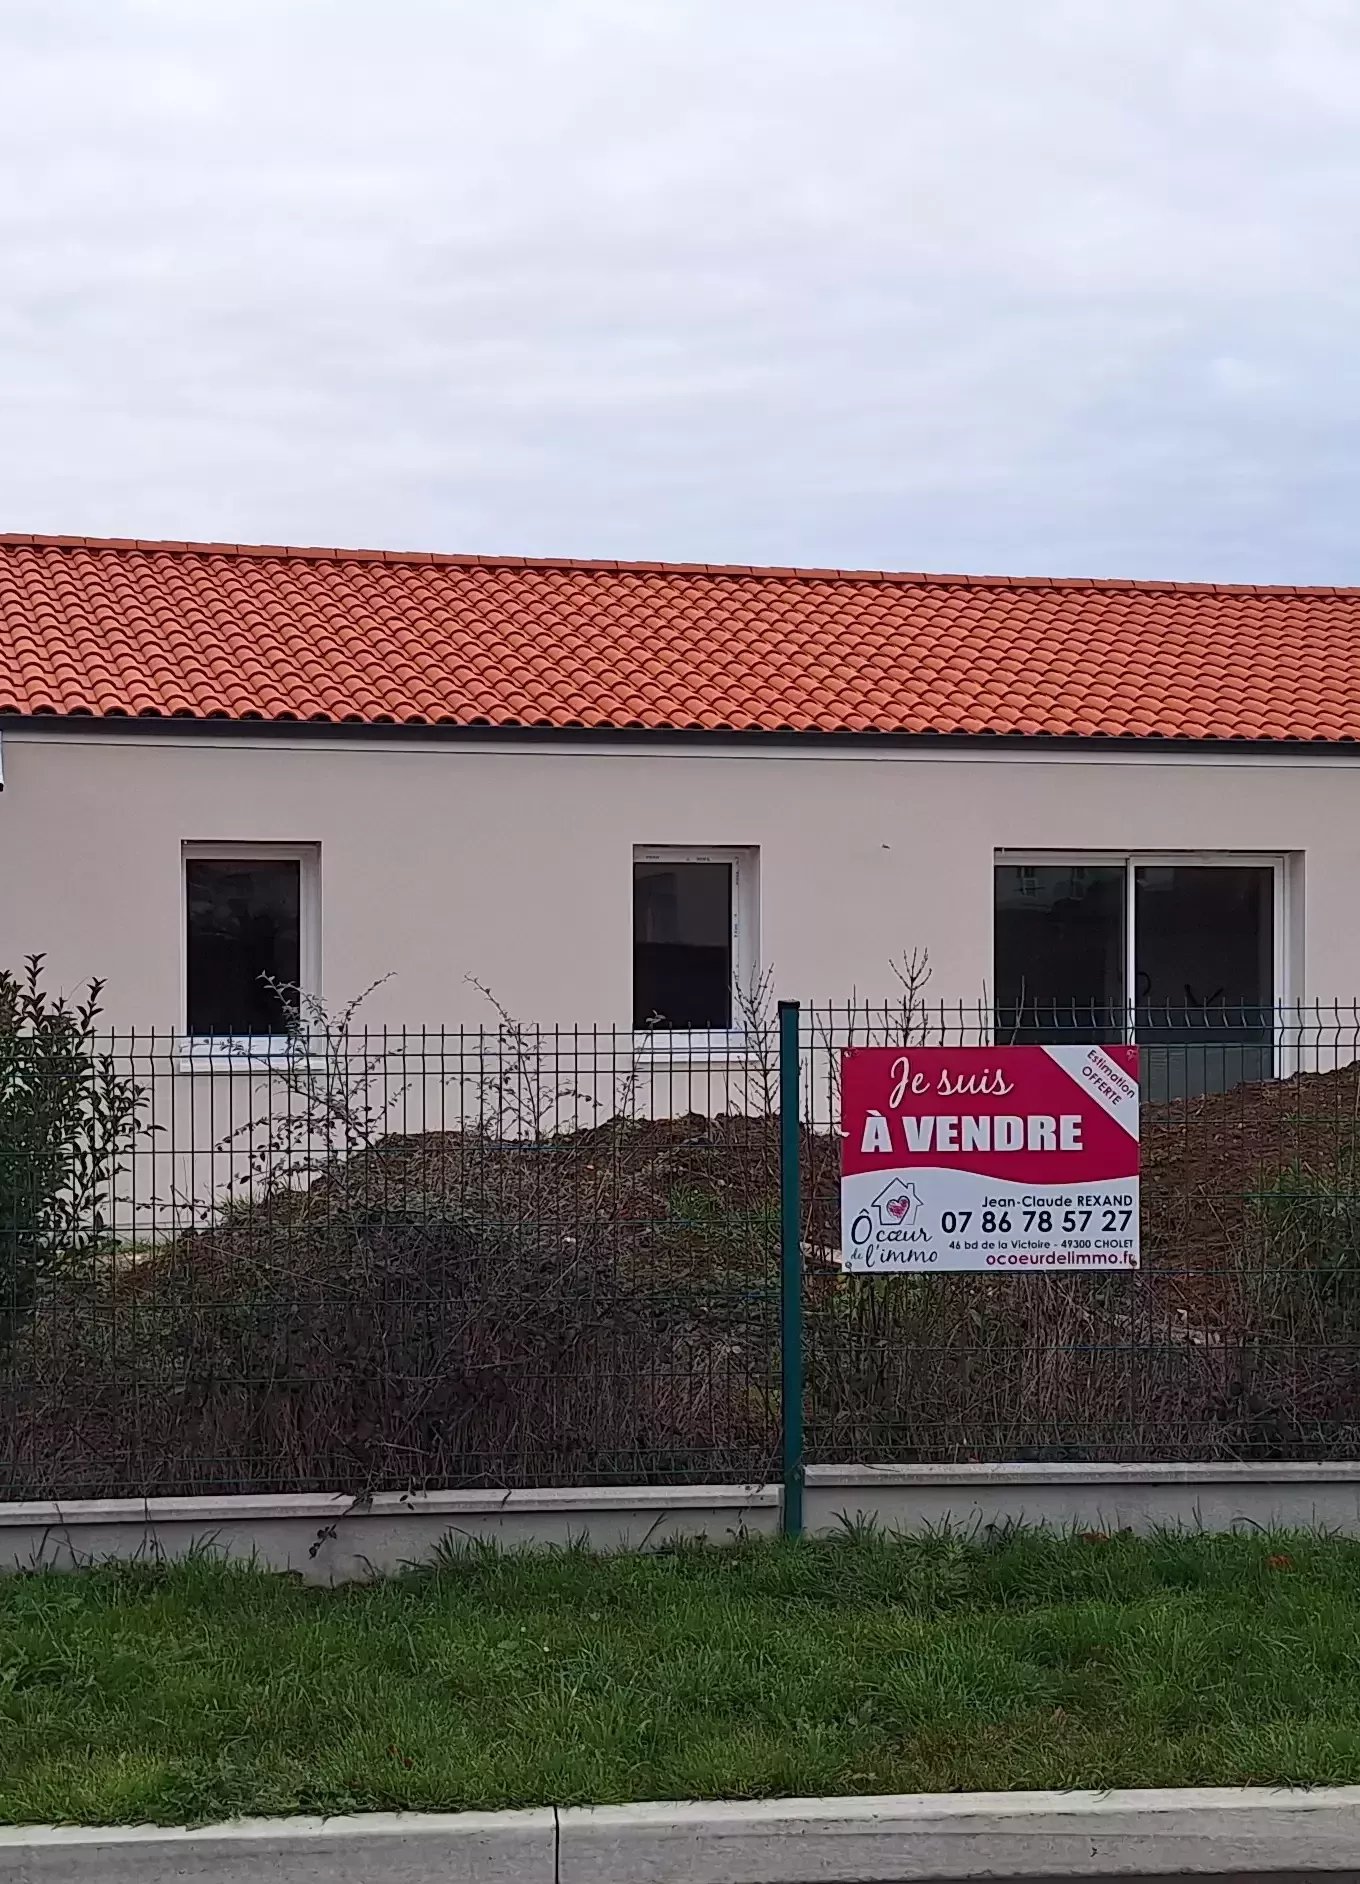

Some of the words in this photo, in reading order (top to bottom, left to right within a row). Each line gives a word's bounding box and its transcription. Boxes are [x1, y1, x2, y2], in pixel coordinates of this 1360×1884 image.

[889, 1057, 930, 1108] Je
[937, 1068, 1014, 1095] suis
[1081, 1066, 1122, 1105] OFFERTE
[1086, 1049, 1136, 1099] Estimation
[861, 1110, 893, 1152] À
[902, 1115, 1083, 1152] VENDRE
[982, 1196, 1072, 1208] Jean-Claude
[1077, 1196, 1132, 1206] REXAND
[941, 1212, 972, 1234] 07
[982, 1211, 1012, 1233] 86
[1023, 1211, 1053, 1233] 78
[1062, 1211, 1092, 1232] 57
[1102, 1210, 1132, 1231] 27
[949, 1242, 961, 1250] 46
[964, 1240, 978, 1250] bd
[982, 1240, 995, 1250] de
[998, 1240, 1008, 1249] la
[1011, 1240, 1050, 1249] Victoire
[1061, 1240, 1091, 1248] 49300
[1095, 1239, 1133, 1248] CHOLET
